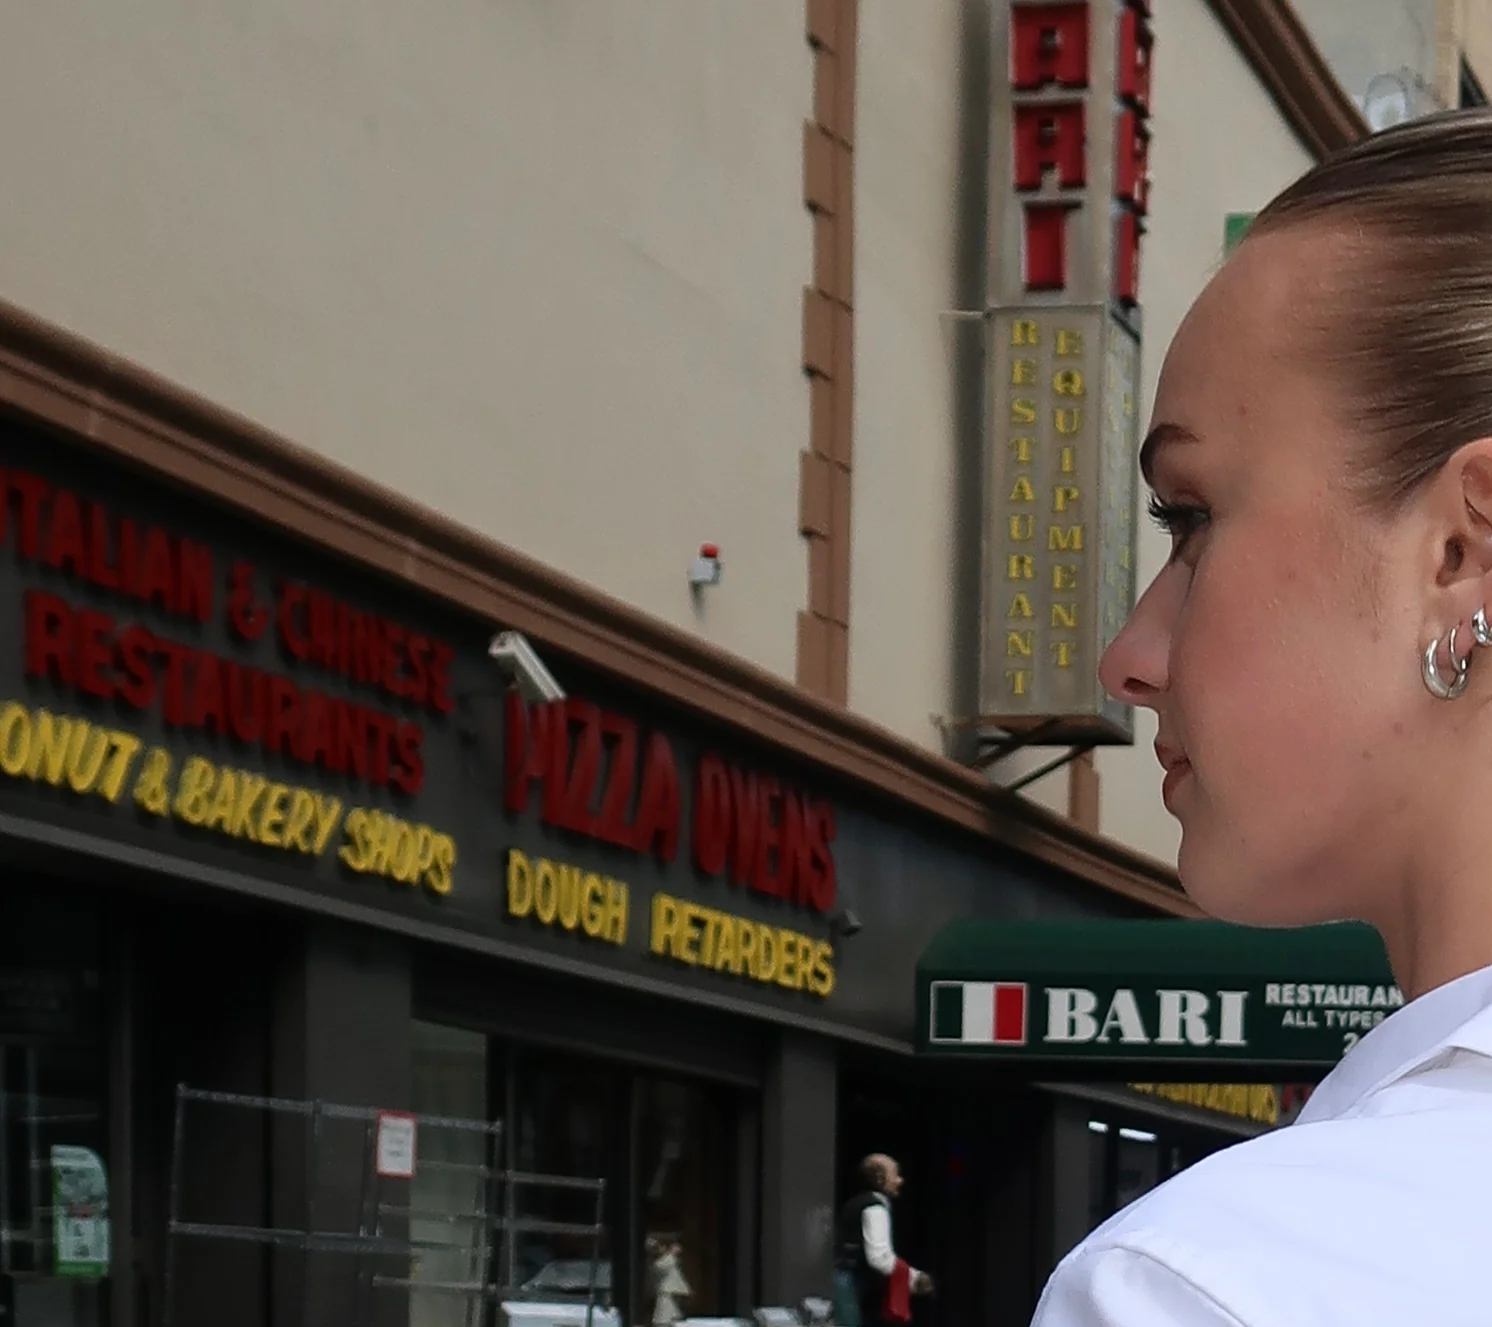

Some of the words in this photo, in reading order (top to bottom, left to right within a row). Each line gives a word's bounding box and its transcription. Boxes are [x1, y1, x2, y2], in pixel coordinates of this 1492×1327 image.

[1005, 320, 1040, 695] RESTAURANT
[1047, 329, 1086, 669] EQUIPMENT
[24, 587, 425, 796] RESTAURANTS
[226, 560, 269, 641] &
[274, 575, 456, 716] CHINESE
[133, 745, 172, 818] &
[174, 756, 342, 857] BAKERY
[338, 806, 457, 896] SHOPS
[505, 685, 681, 865] PIZZA
[693, 748, 836, 914] OVENS
[508, 847, 631, 946] DOUGH
[651, 891, 836, 998] RETARDERS
[1043, 987, 1249, 1047] BARI
[1281, 1009, 1319, 1028] ALL
[1324, 1010, 1386, 1029] TYPES
